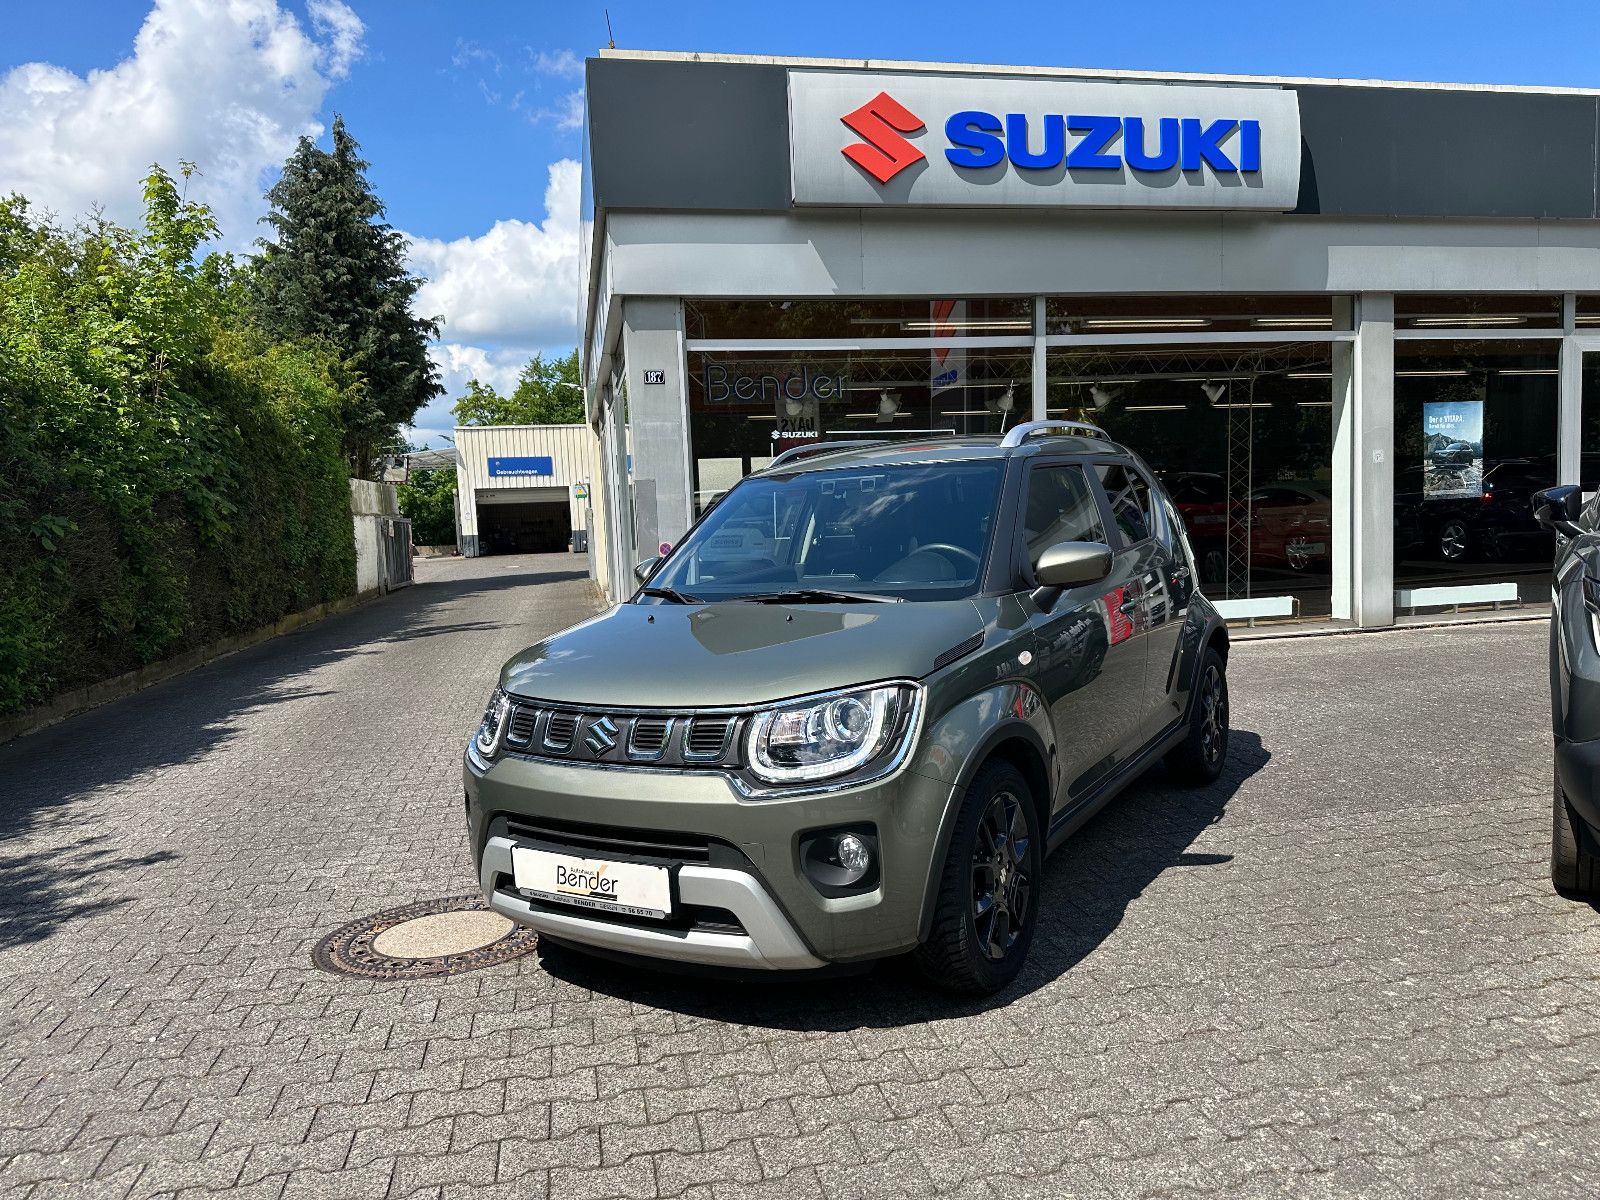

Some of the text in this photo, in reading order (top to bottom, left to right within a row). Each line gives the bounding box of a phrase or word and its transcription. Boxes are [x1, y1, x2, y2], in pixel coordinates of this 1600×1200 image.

[944, 110, 1260, 173] SUZUKI
[646, 371, 663, 383] 187
[706, 365, 848, 400] Bender
[557, 865, 619, 892] Bender
[573, 898, 596, 907] BENDER
